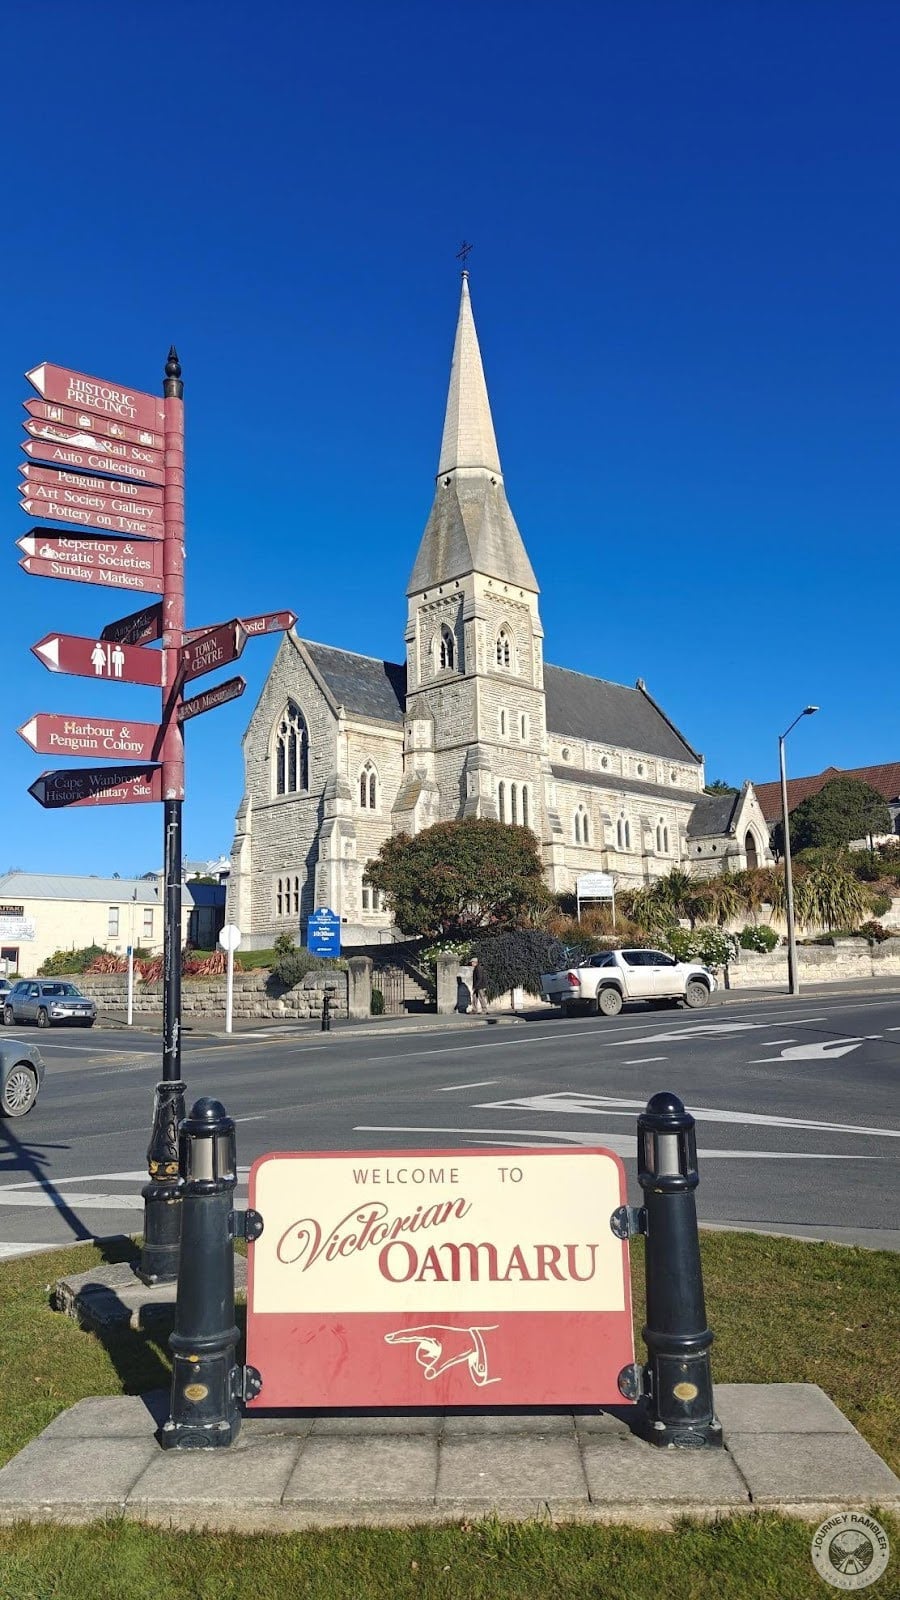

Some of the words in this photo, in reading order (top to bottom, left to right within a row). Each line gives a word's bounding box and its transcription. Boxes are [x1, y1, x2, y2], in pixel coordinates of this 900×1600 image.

[67, 388, 138, 419] PRECINCT
[69, 378, 135, 407] HISTORIC
[52, 448, 83, 463] Auto
[88, 455, 146, 478] Collection
[102, 440, 127, 457] Rail
[131, 448, 154, 463] Soc.
[57, 471, 105, 489] Penguin
[110, 480, 138, 495] Club
[35, 486, 58, 499] Art
[64, 491, 106, 509] Society
[111, 499, 154, 517] Gallery
[48, 503, 91, 523] Pottery
[96, 515, 111, 525] on
[117, 516, 147, 532] Tyne
[57, 537, 118, 555] Repertory
[123, 543, 134, 555] &
[98, 552, 151, 569] Societies
[51, 562, 94, 580] Sunday
[99, 571, 144, 587] Markets
[245, 618, 266, 634] ostel
[191, 647, 224, 672] CENTRE
[194, 637, 218, 659] TOWN
[64, 722, 115, 737] Harbour
[119, 727, 130, 738] &
[49, 734, 98, 750] Penguin
[103, 738, 145, 754] Colony
[46, 789, 85, 802] Historic
[88, 785, 129, 800] Military
[133, 784, 151, 795] Site
[54, 778, 84, 791] Cape
[88, 774, 142, 787] Wanbrow
[352, 1168, 460, 1184] WELCOME
[497, 1167, 523, 1183] TO
[276, 1197, 473, 1272] Victorian
[378, 1241, 599, 1283] OAMARU
